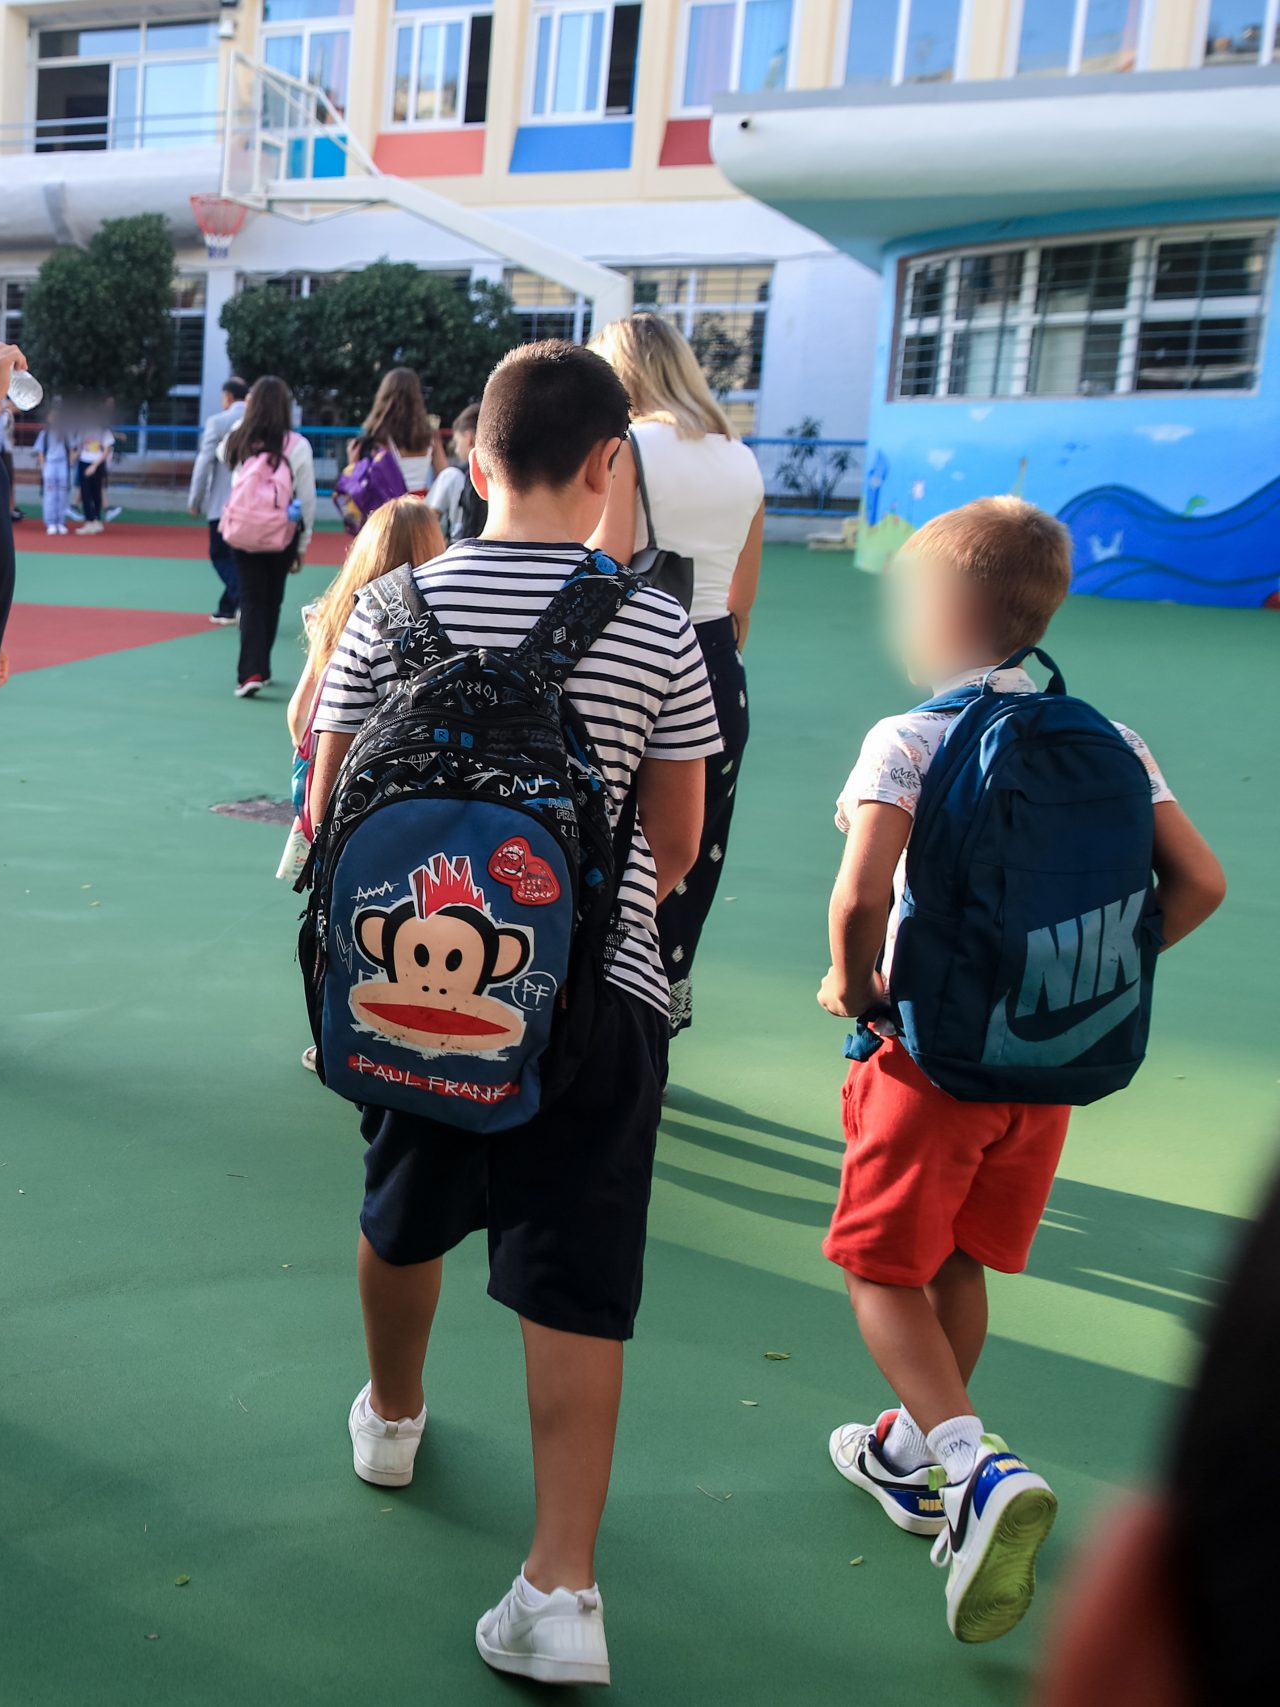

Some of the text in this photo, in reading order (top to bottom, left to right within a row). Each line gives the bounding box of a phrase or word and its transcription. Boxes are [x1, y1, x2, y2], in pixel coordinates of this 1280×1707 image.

[522, 979, 550, 1005] PF
[353, 1052, 511, 1102] PAUL FRANK
